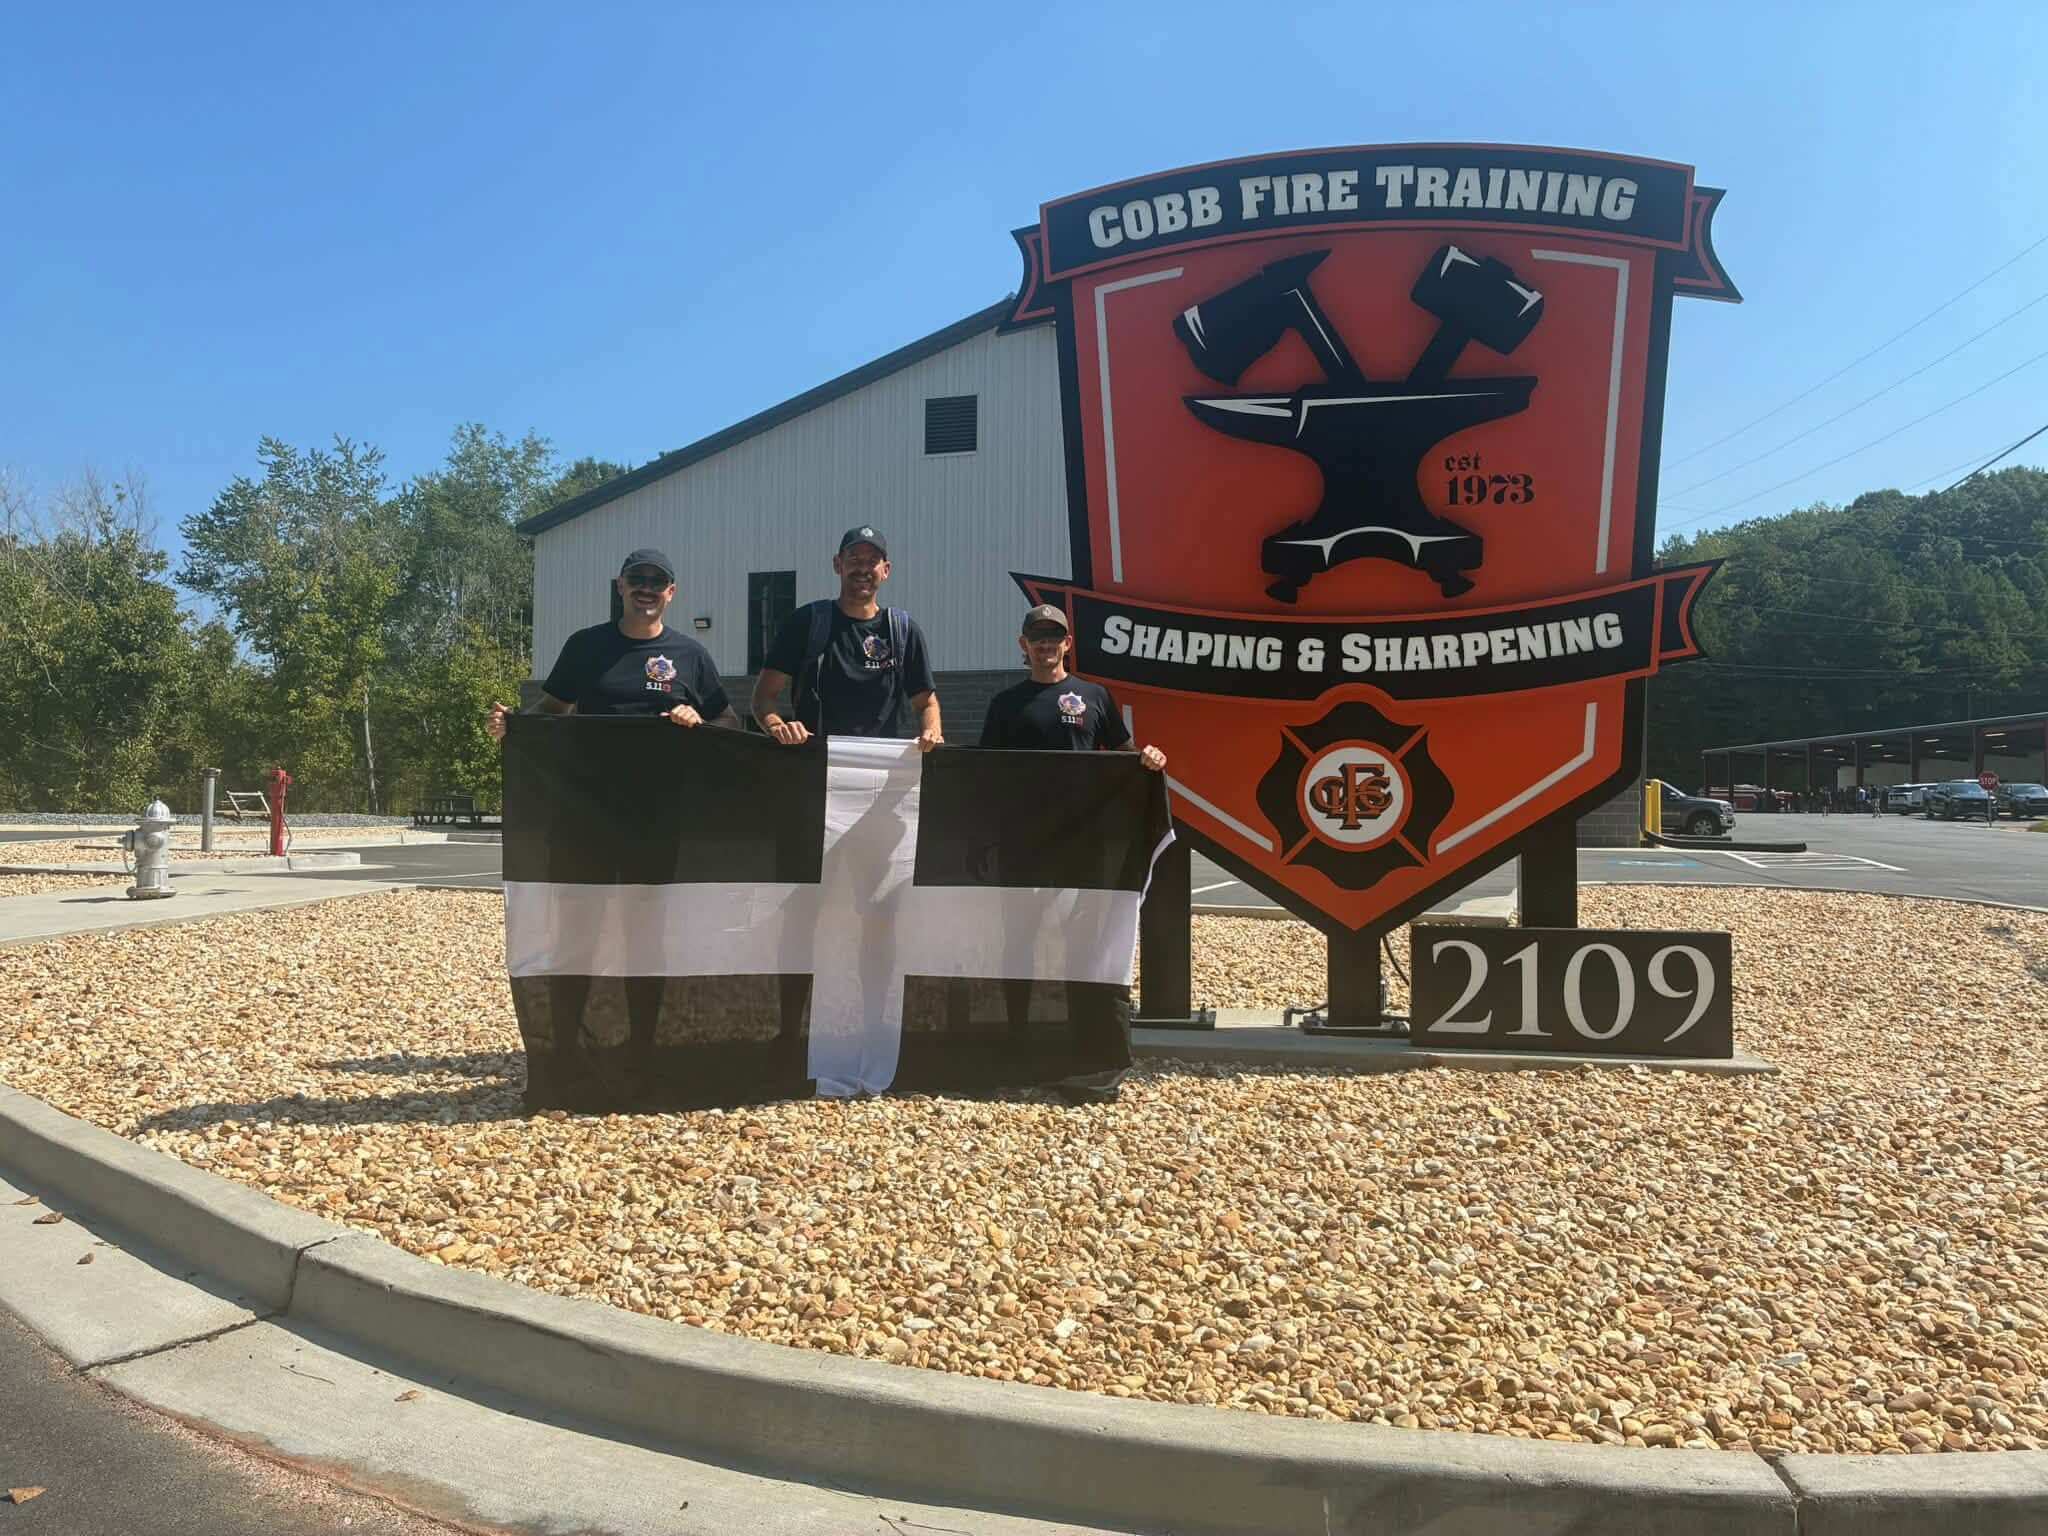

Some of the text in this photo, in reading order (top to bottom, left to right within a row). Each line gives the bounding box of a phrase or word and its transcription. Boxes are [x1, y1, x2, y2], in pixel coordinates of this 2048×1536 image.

[1088, 165, 1638, 248] COBB FIRE TRAINING
[1445, 452, 1481, 472] est
[1446, 474, 1535, 505] 1973
[1101, 612, 1623, 673] SHAPING & SHARPENING
[1980, 777, 1997, 785] STOP
[1430, 938, 1717, 1043] 2109
